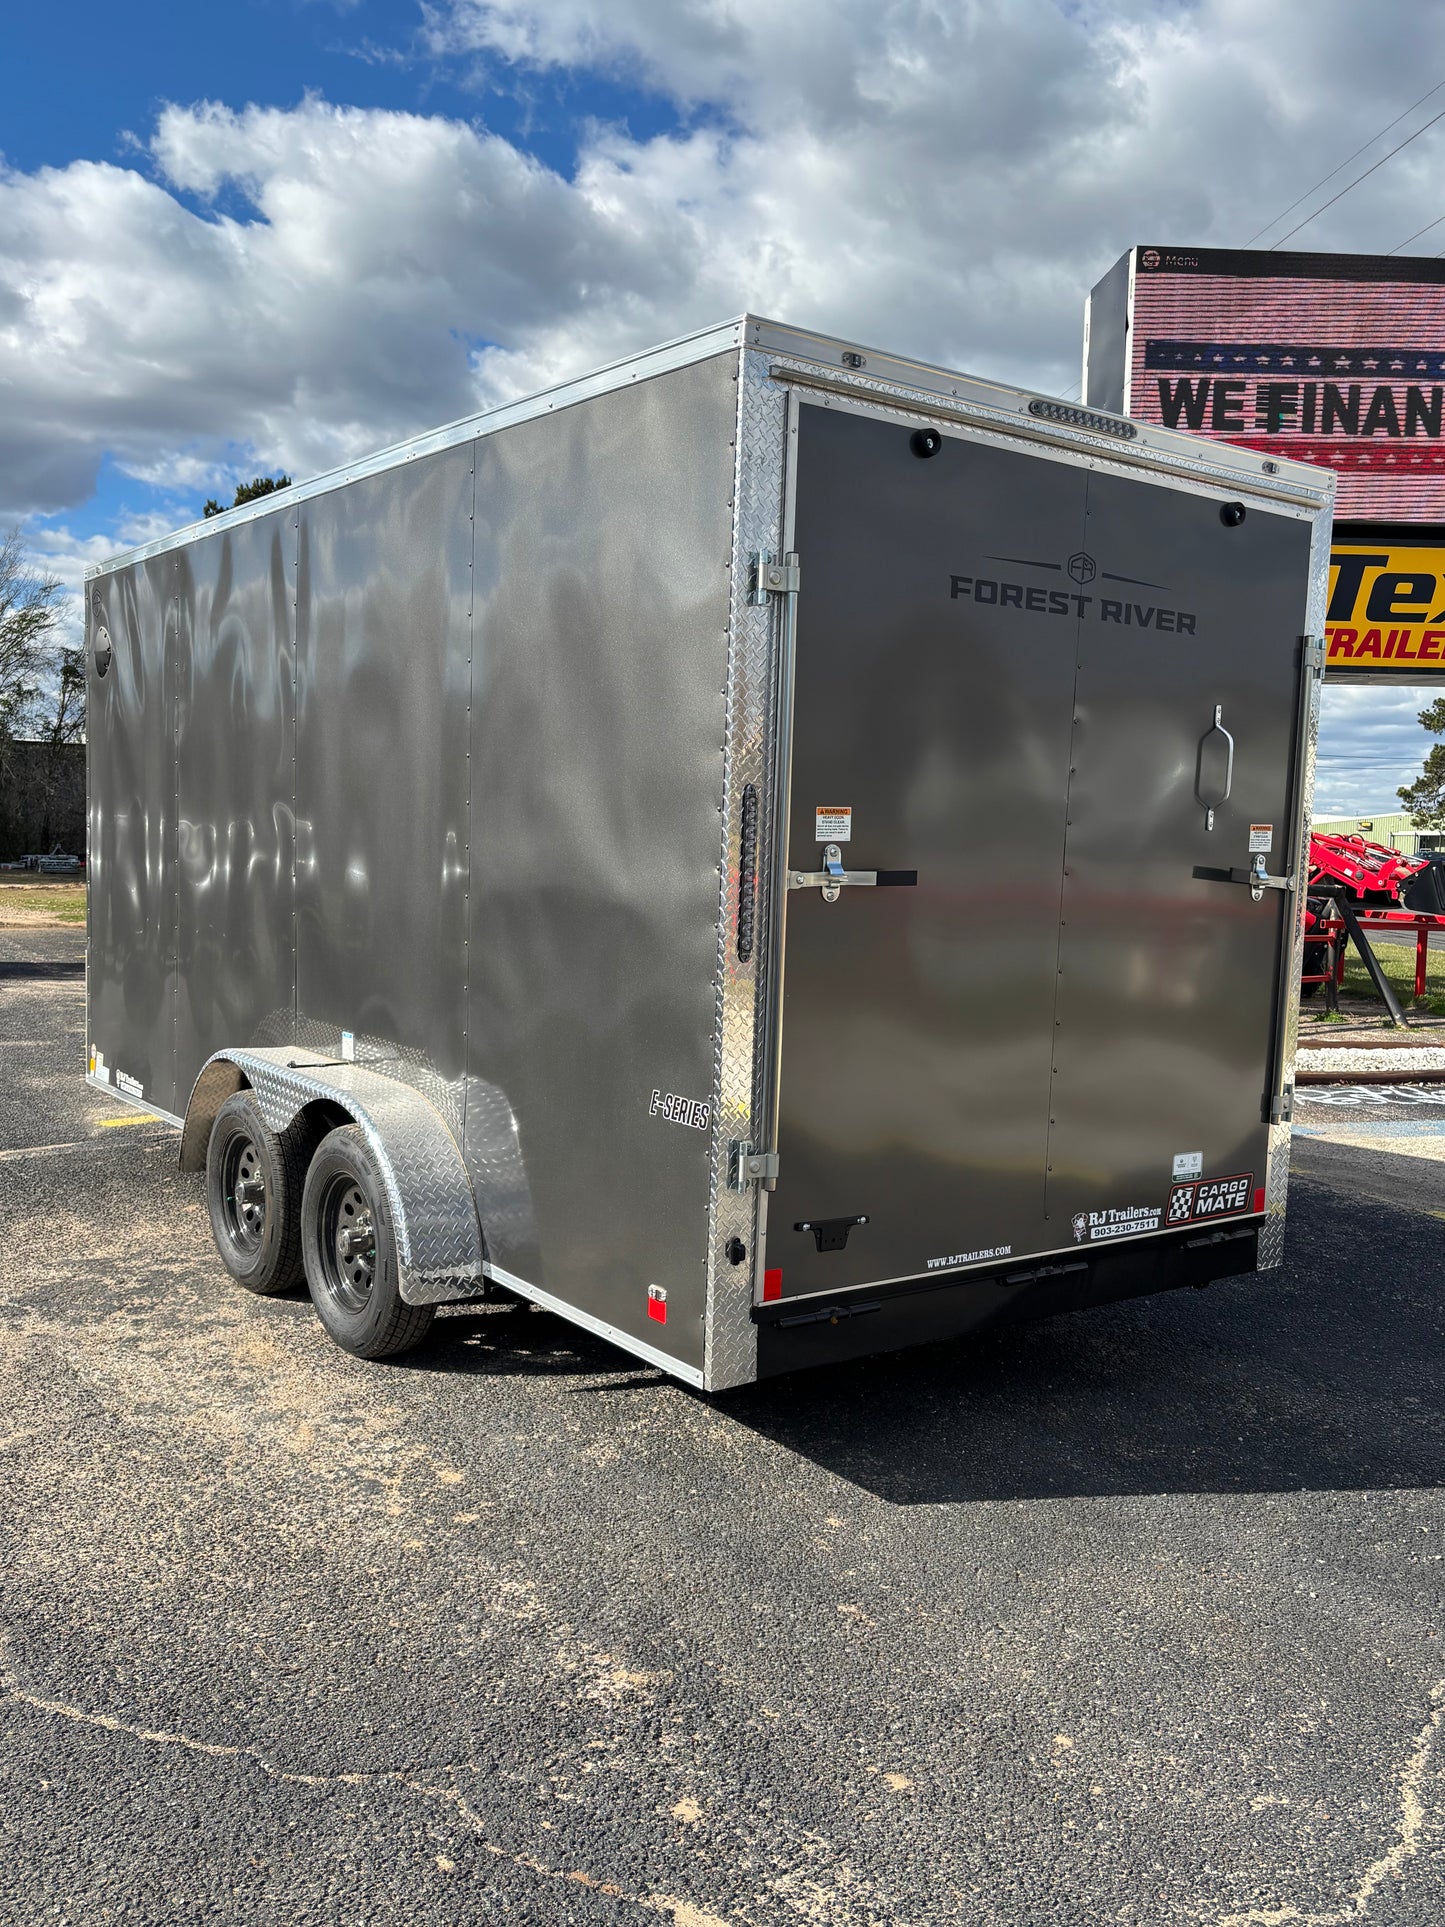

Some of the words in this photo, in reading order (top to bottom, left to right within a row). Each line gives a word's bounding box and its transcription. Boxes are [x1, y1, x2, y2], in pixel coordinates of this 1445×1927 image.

[1158, 377, 1246, 431] WE
[950, 575, 1092, 618] FOREST
[1100, 598, 1196, 635] RIVER
[1324, 628, 1445, 660] RAILE
[649, 1089, 710, 1130] E-SERIES
[1199, 1180, 1248, 1197] CARGO
[1196, 1192, 1246, 1214] MATE
[1094, 1220, 1156, 1236] 903-230-7511
[926, 1245, 1011, 1268] WWW.RJTRAILERS.COM
